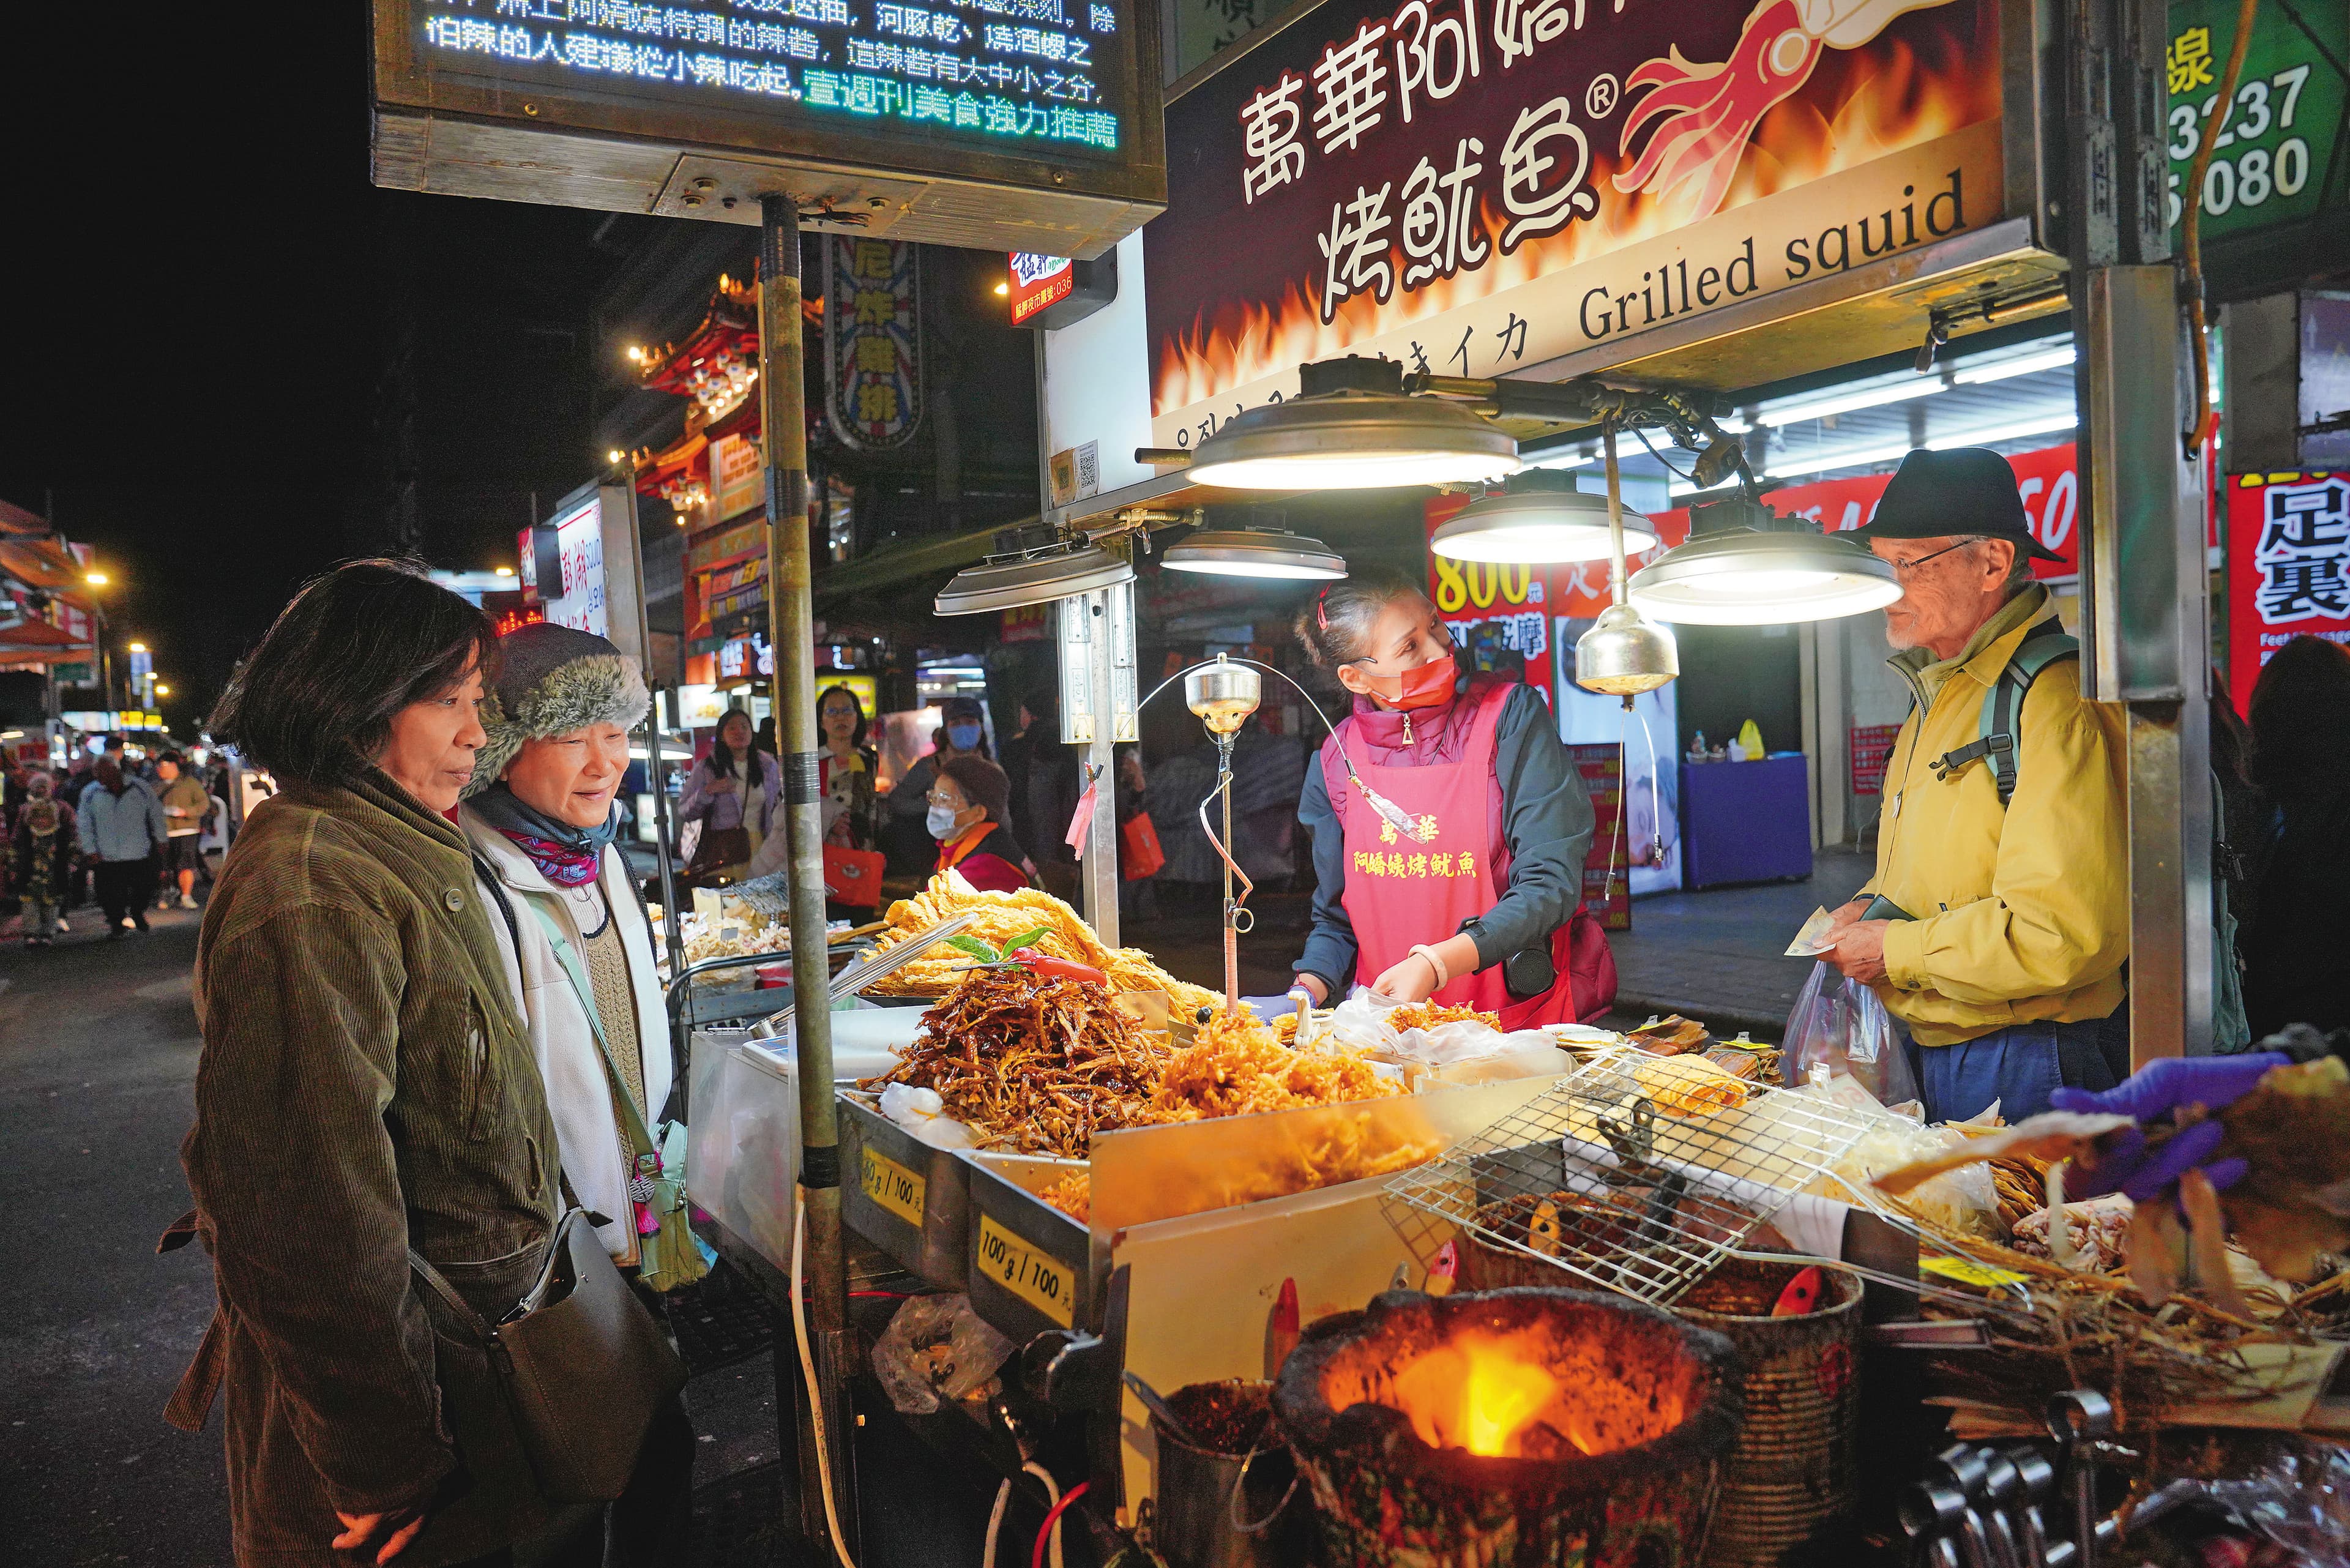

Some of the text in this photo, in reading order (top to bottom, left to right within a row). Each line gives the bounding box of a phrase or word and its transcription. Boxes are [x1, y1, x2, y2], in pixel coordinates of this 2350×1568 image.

[1242, 0, 1625, 204] 萬華阿嬌
[1318, 96, 1594, 318] 烤魷魚
[1580, 166, 1967, 340] Grilled squid
[1379, 313, 1527, 375] きイカ
